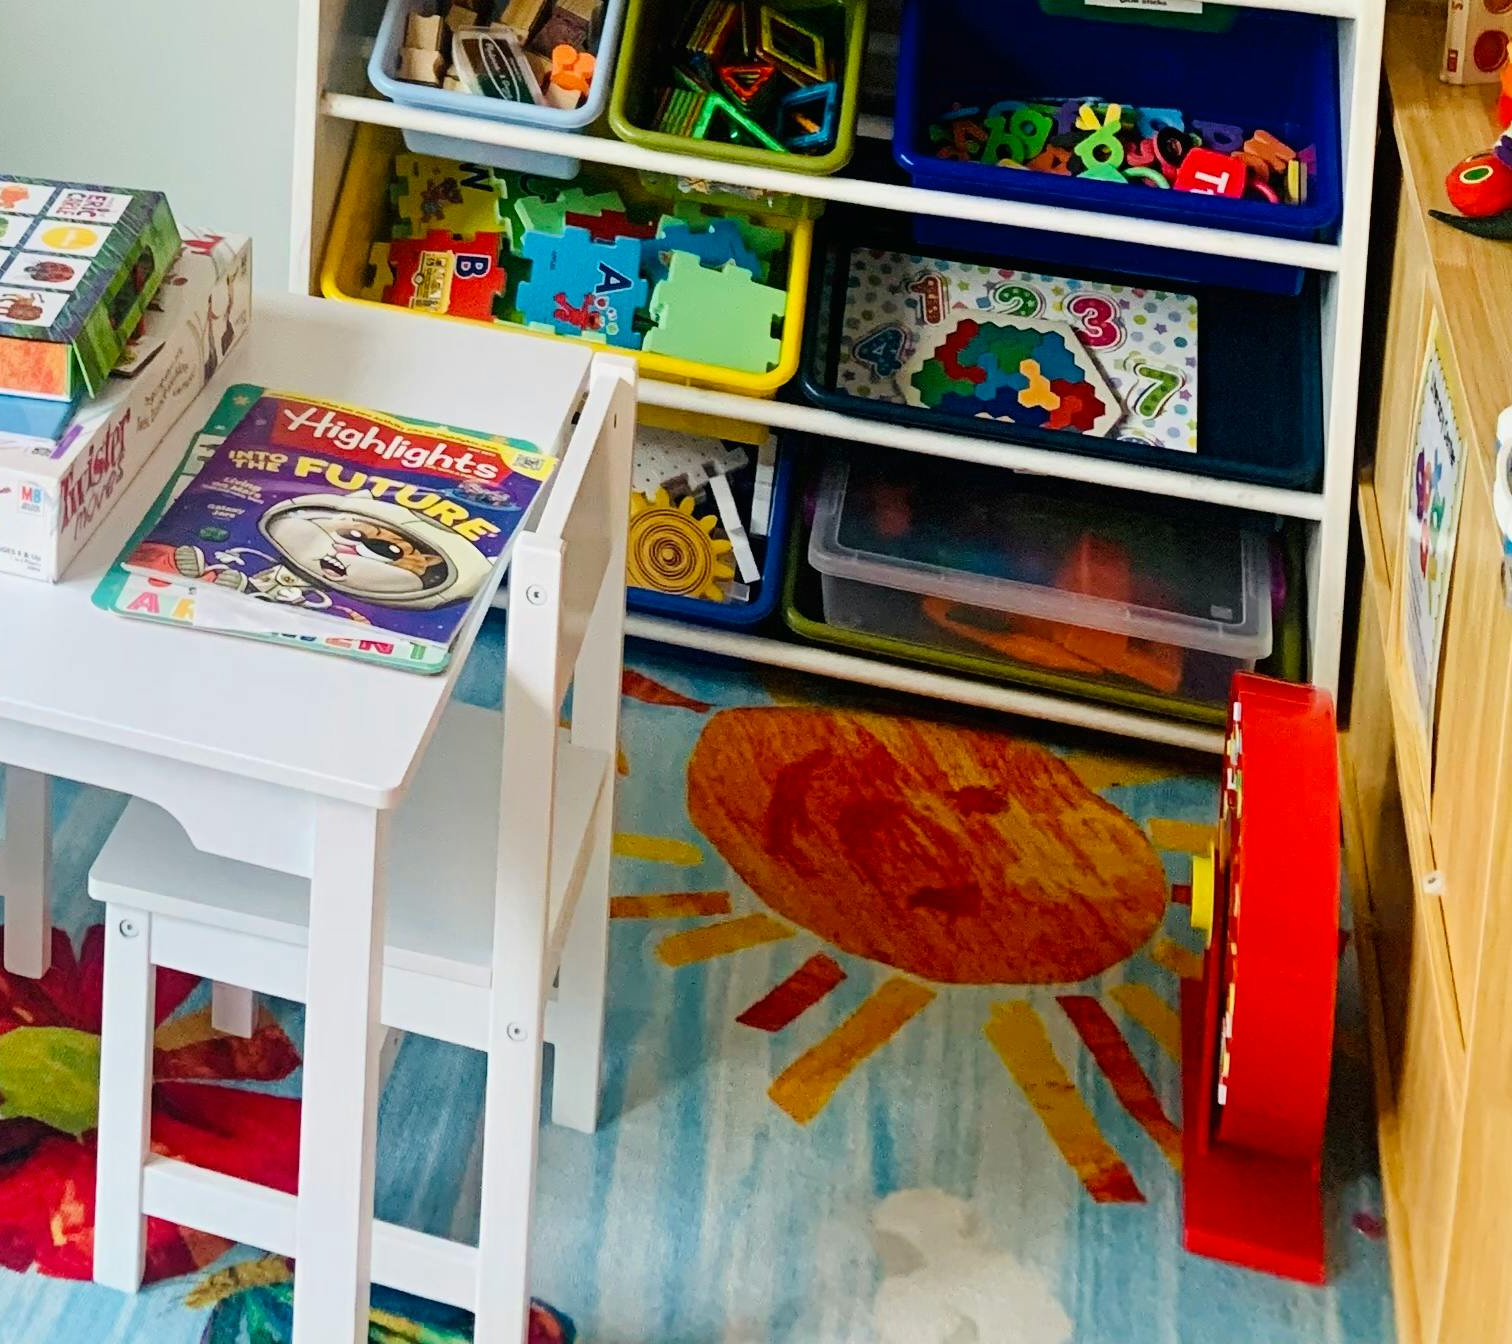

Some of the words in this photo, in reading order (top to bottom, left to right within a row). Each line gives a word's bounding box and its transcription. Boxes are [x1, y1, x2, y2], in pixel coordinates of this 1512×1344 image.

[56, 191, 87, 216] CARLE
[78, 193, 109, 218] ERIC
[284, 407, 499, 479] Highlights
[228, 450, 288, 463] INTO
[231, 459, 281, 472] THE
[60, 408, 131, 534] Twister
[21, 485, 41, 503] MB
[73, 462, 125, 541] moves
[294, 456, 501, 541] FUTURE
